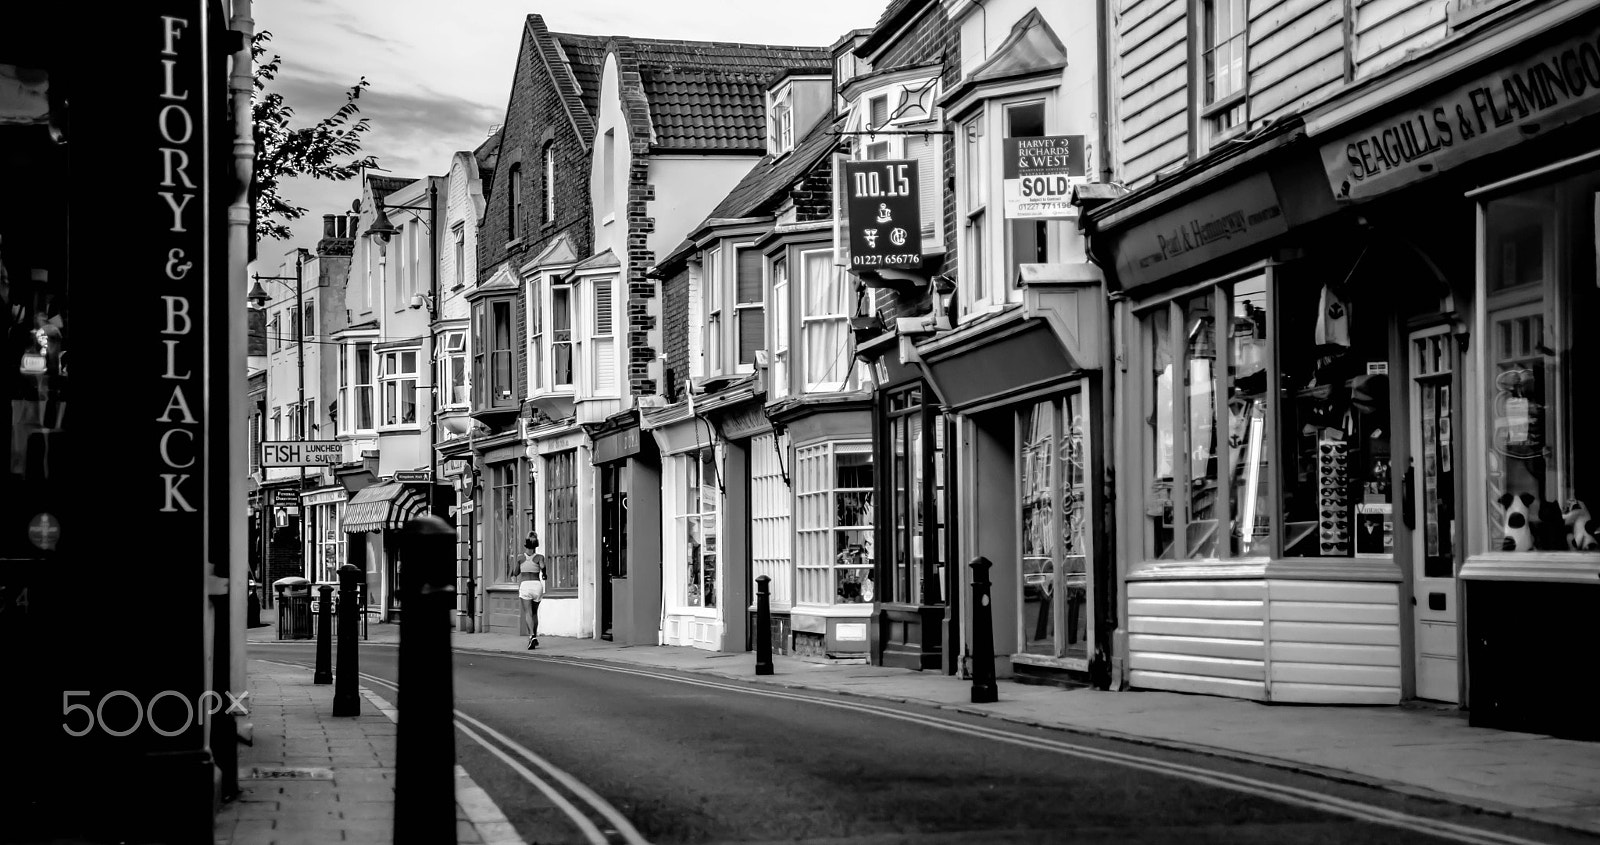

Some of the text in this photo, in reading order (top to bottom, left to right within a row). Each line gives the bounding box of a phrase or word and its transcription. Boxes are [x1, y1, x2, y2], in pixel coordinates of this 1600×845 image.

[1346, 36, 1600, 181] SEAGULLS & FLAMINGO
[1018, 139, 1056, 148] HARVEY
[1018, 147, 1069, 156] RICHARDS
[1018, 155, 1069, 168] & WEST
[1022, 176, 1068, 197] SOLD
[156, 15, 198, 513] FLORY & BLACK
[853, 254, 920, 265] 01227 656776
[264, 445, 300, 463] FISH
